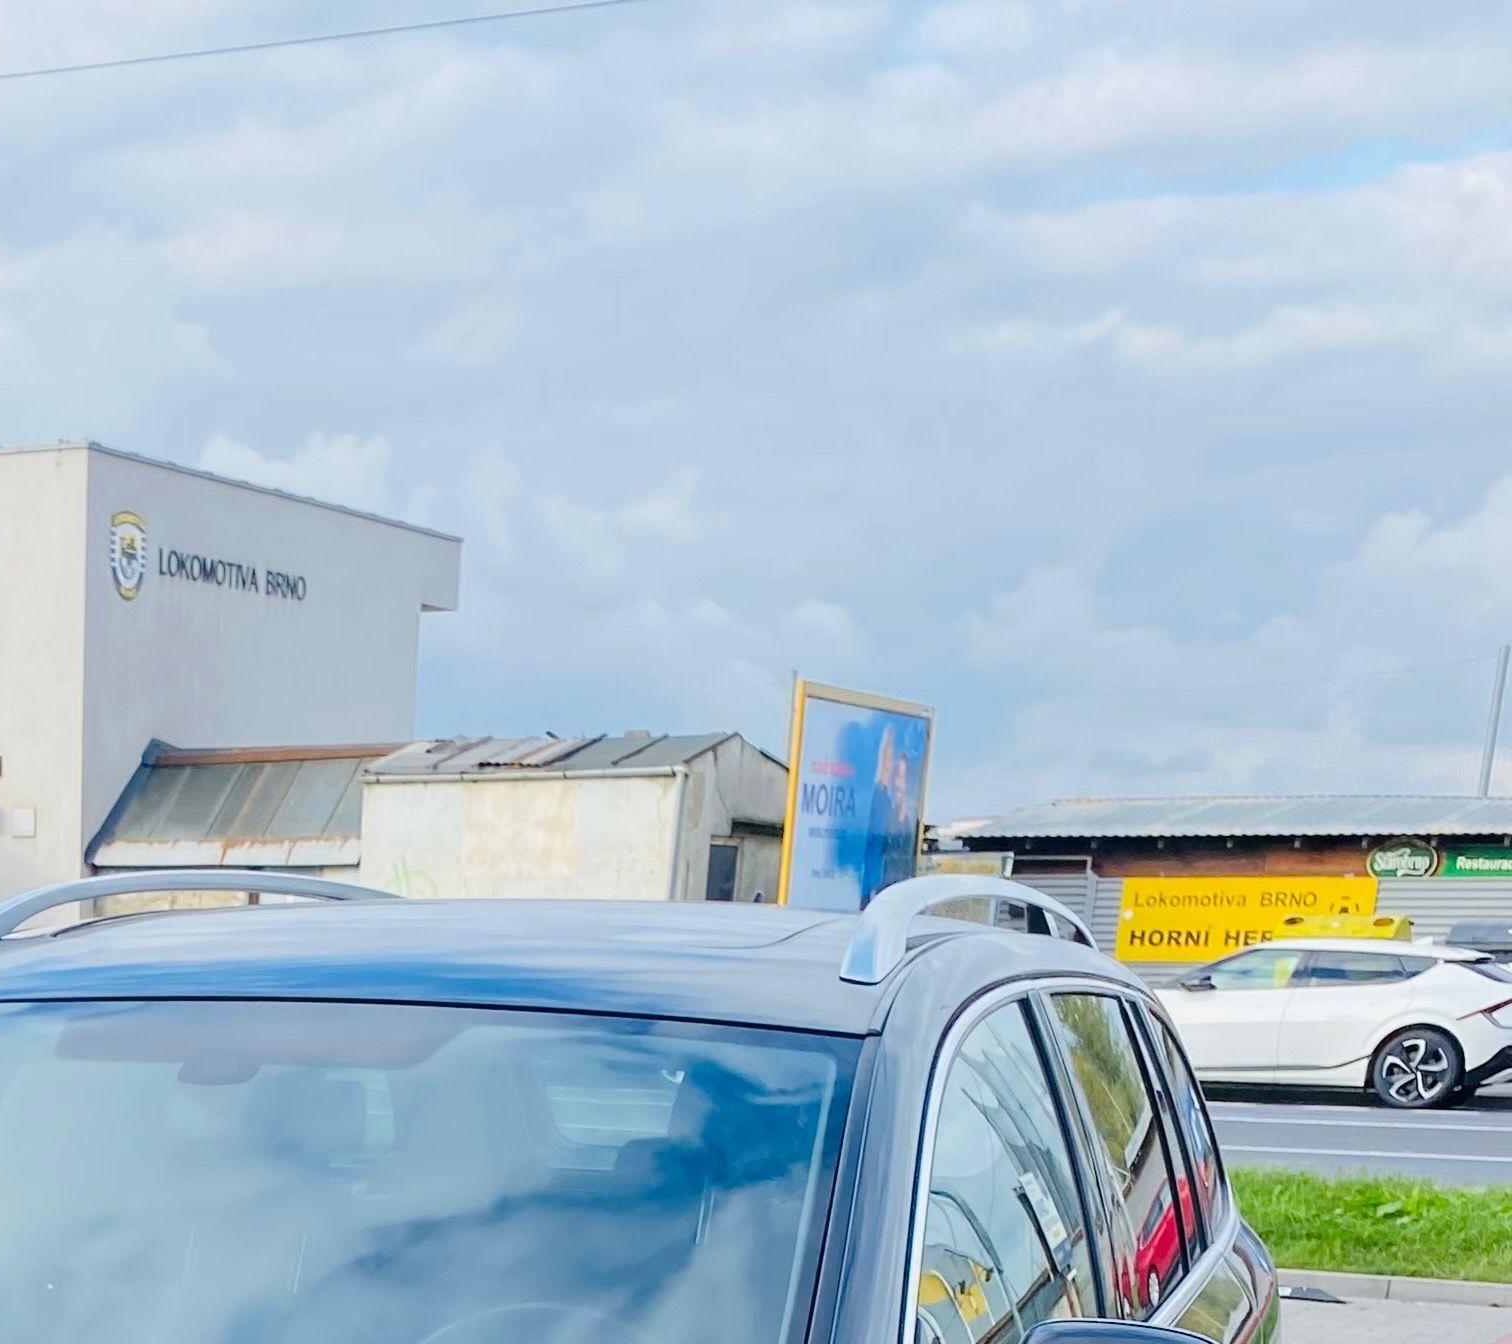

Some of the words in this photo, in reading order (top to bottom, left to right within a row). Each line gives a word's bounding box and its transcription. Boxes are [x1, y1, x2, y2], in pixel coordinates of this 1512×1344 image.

[158, 547, 259, 593] LOKOMOTIVA
[265, 570, 307, 601] BRNO
[801, 783, 856, 817] MOIRA
[1133, 891, 1247, 908] Lokomotiva
[1260, 891, 1318, 908] BRNO
